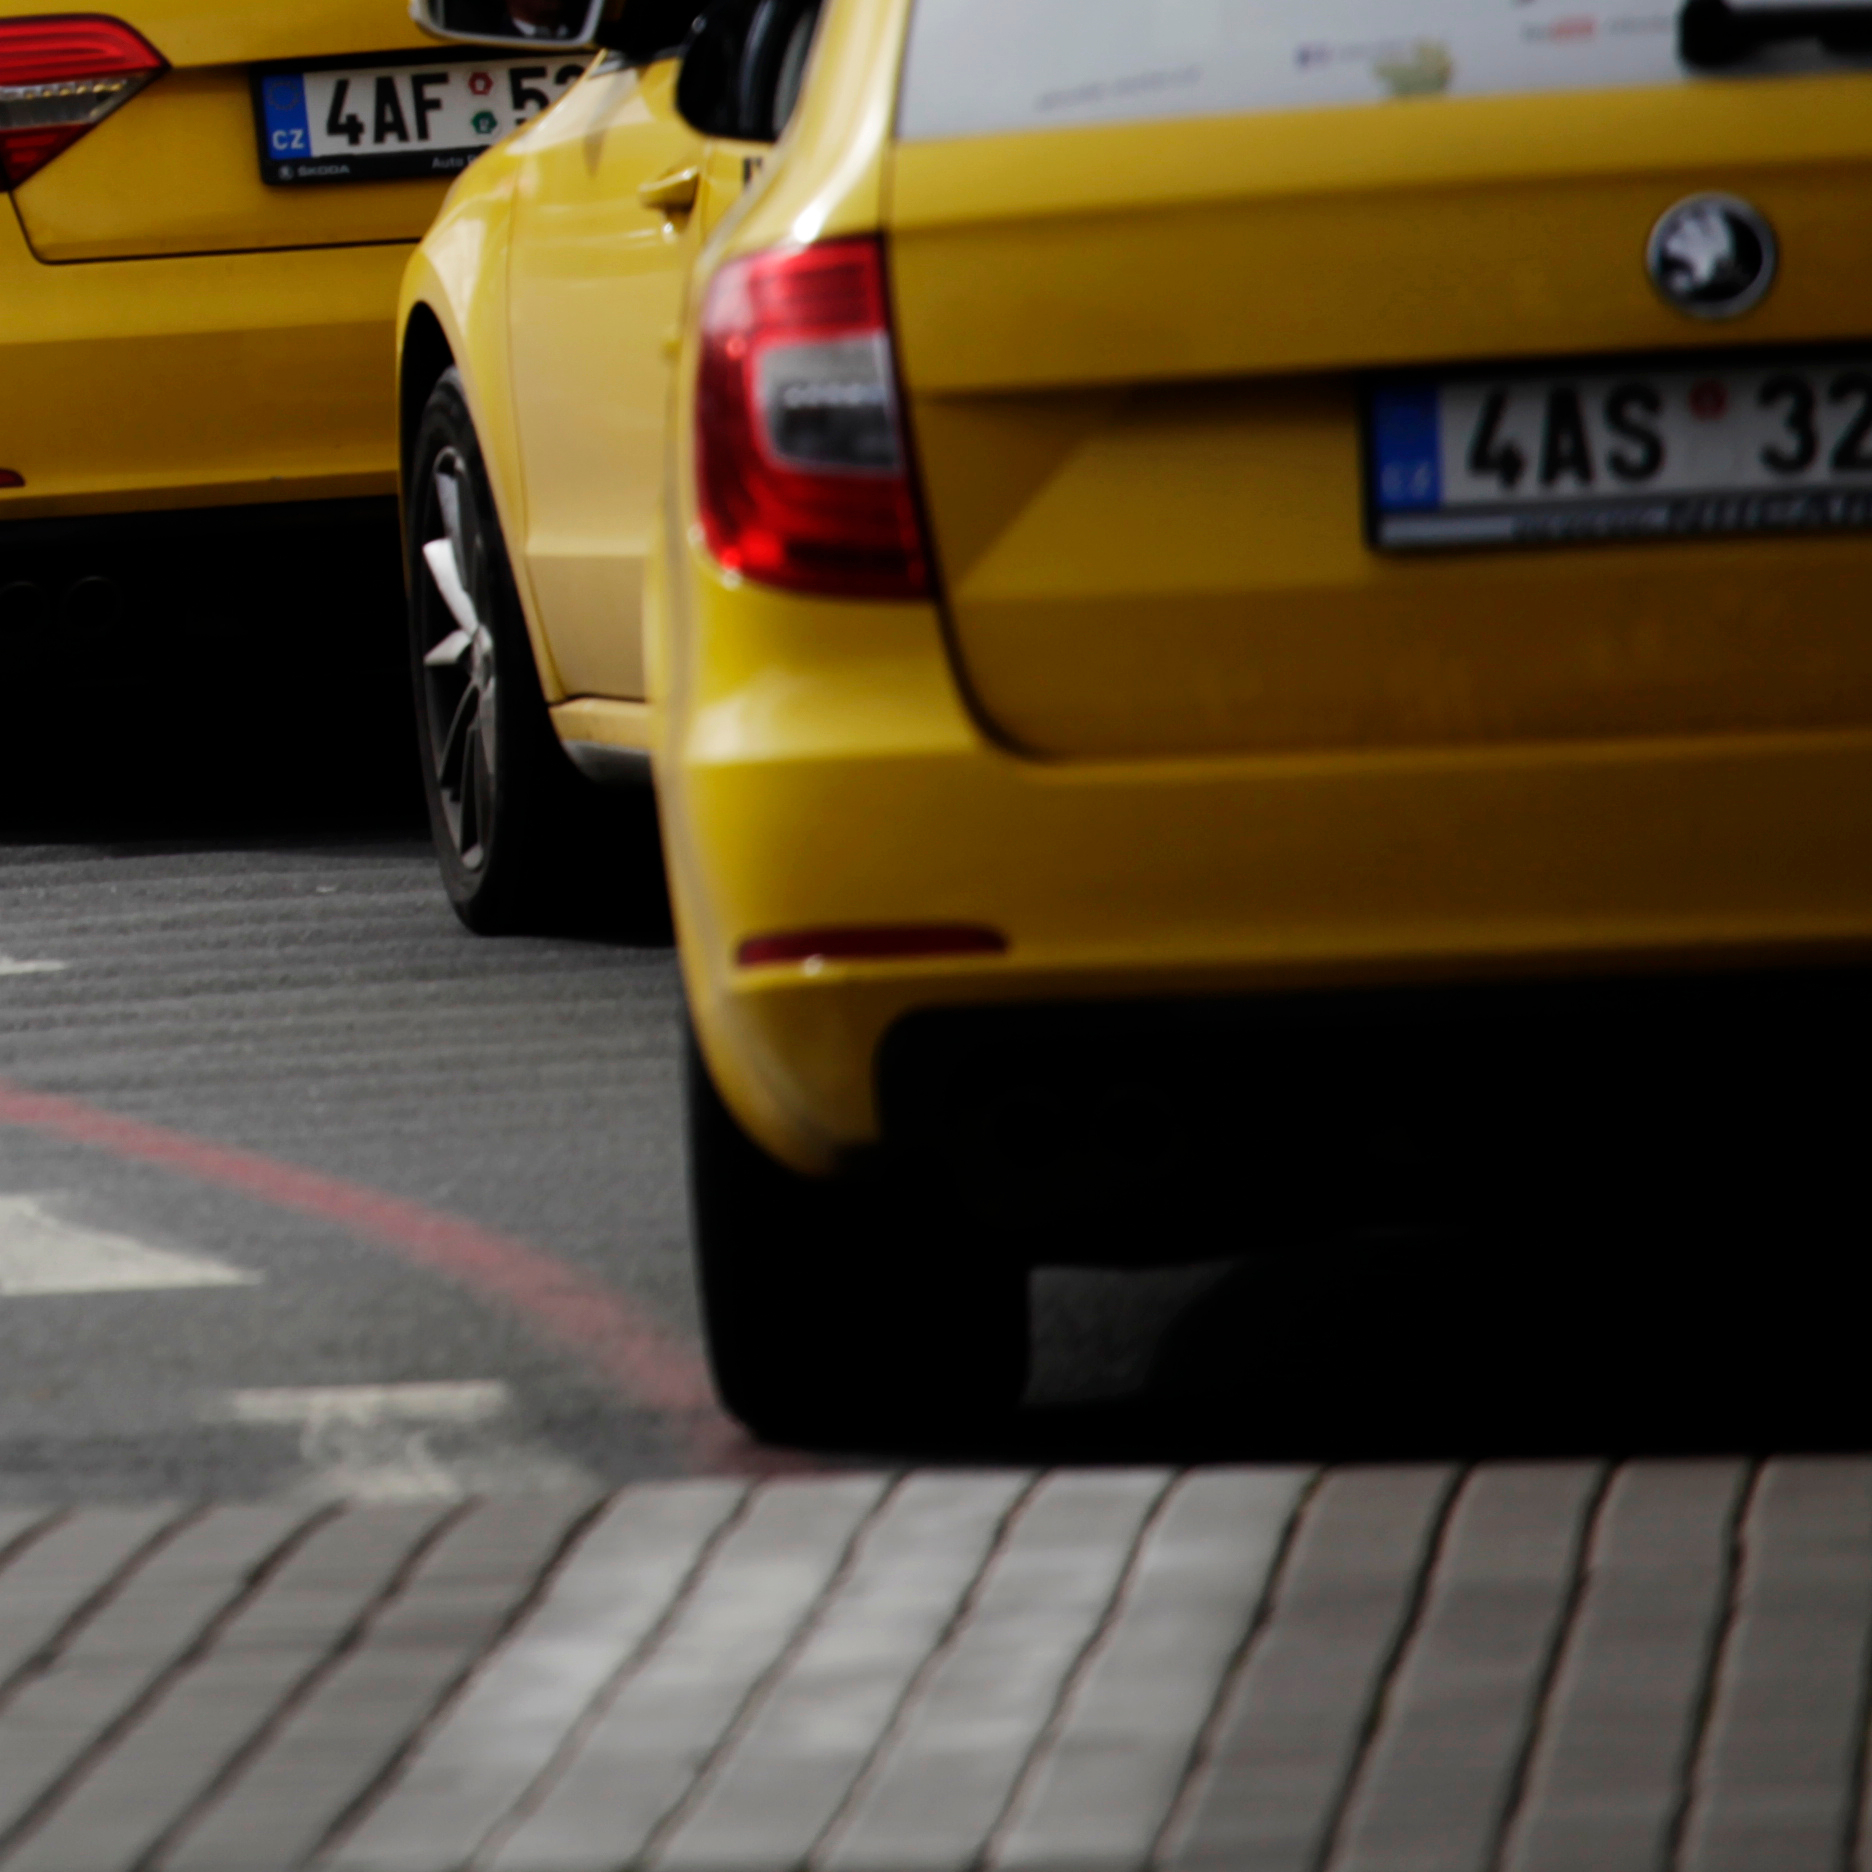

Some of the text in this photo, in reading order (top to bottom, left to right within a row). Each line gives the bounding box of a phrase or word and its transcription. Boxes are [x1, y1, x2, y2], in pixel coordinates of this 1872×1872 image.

[271, 129, 305, 151] CZ
[325, 71, 451, 147] 4AF
[1466, 381, 1667, 490] 4AS
